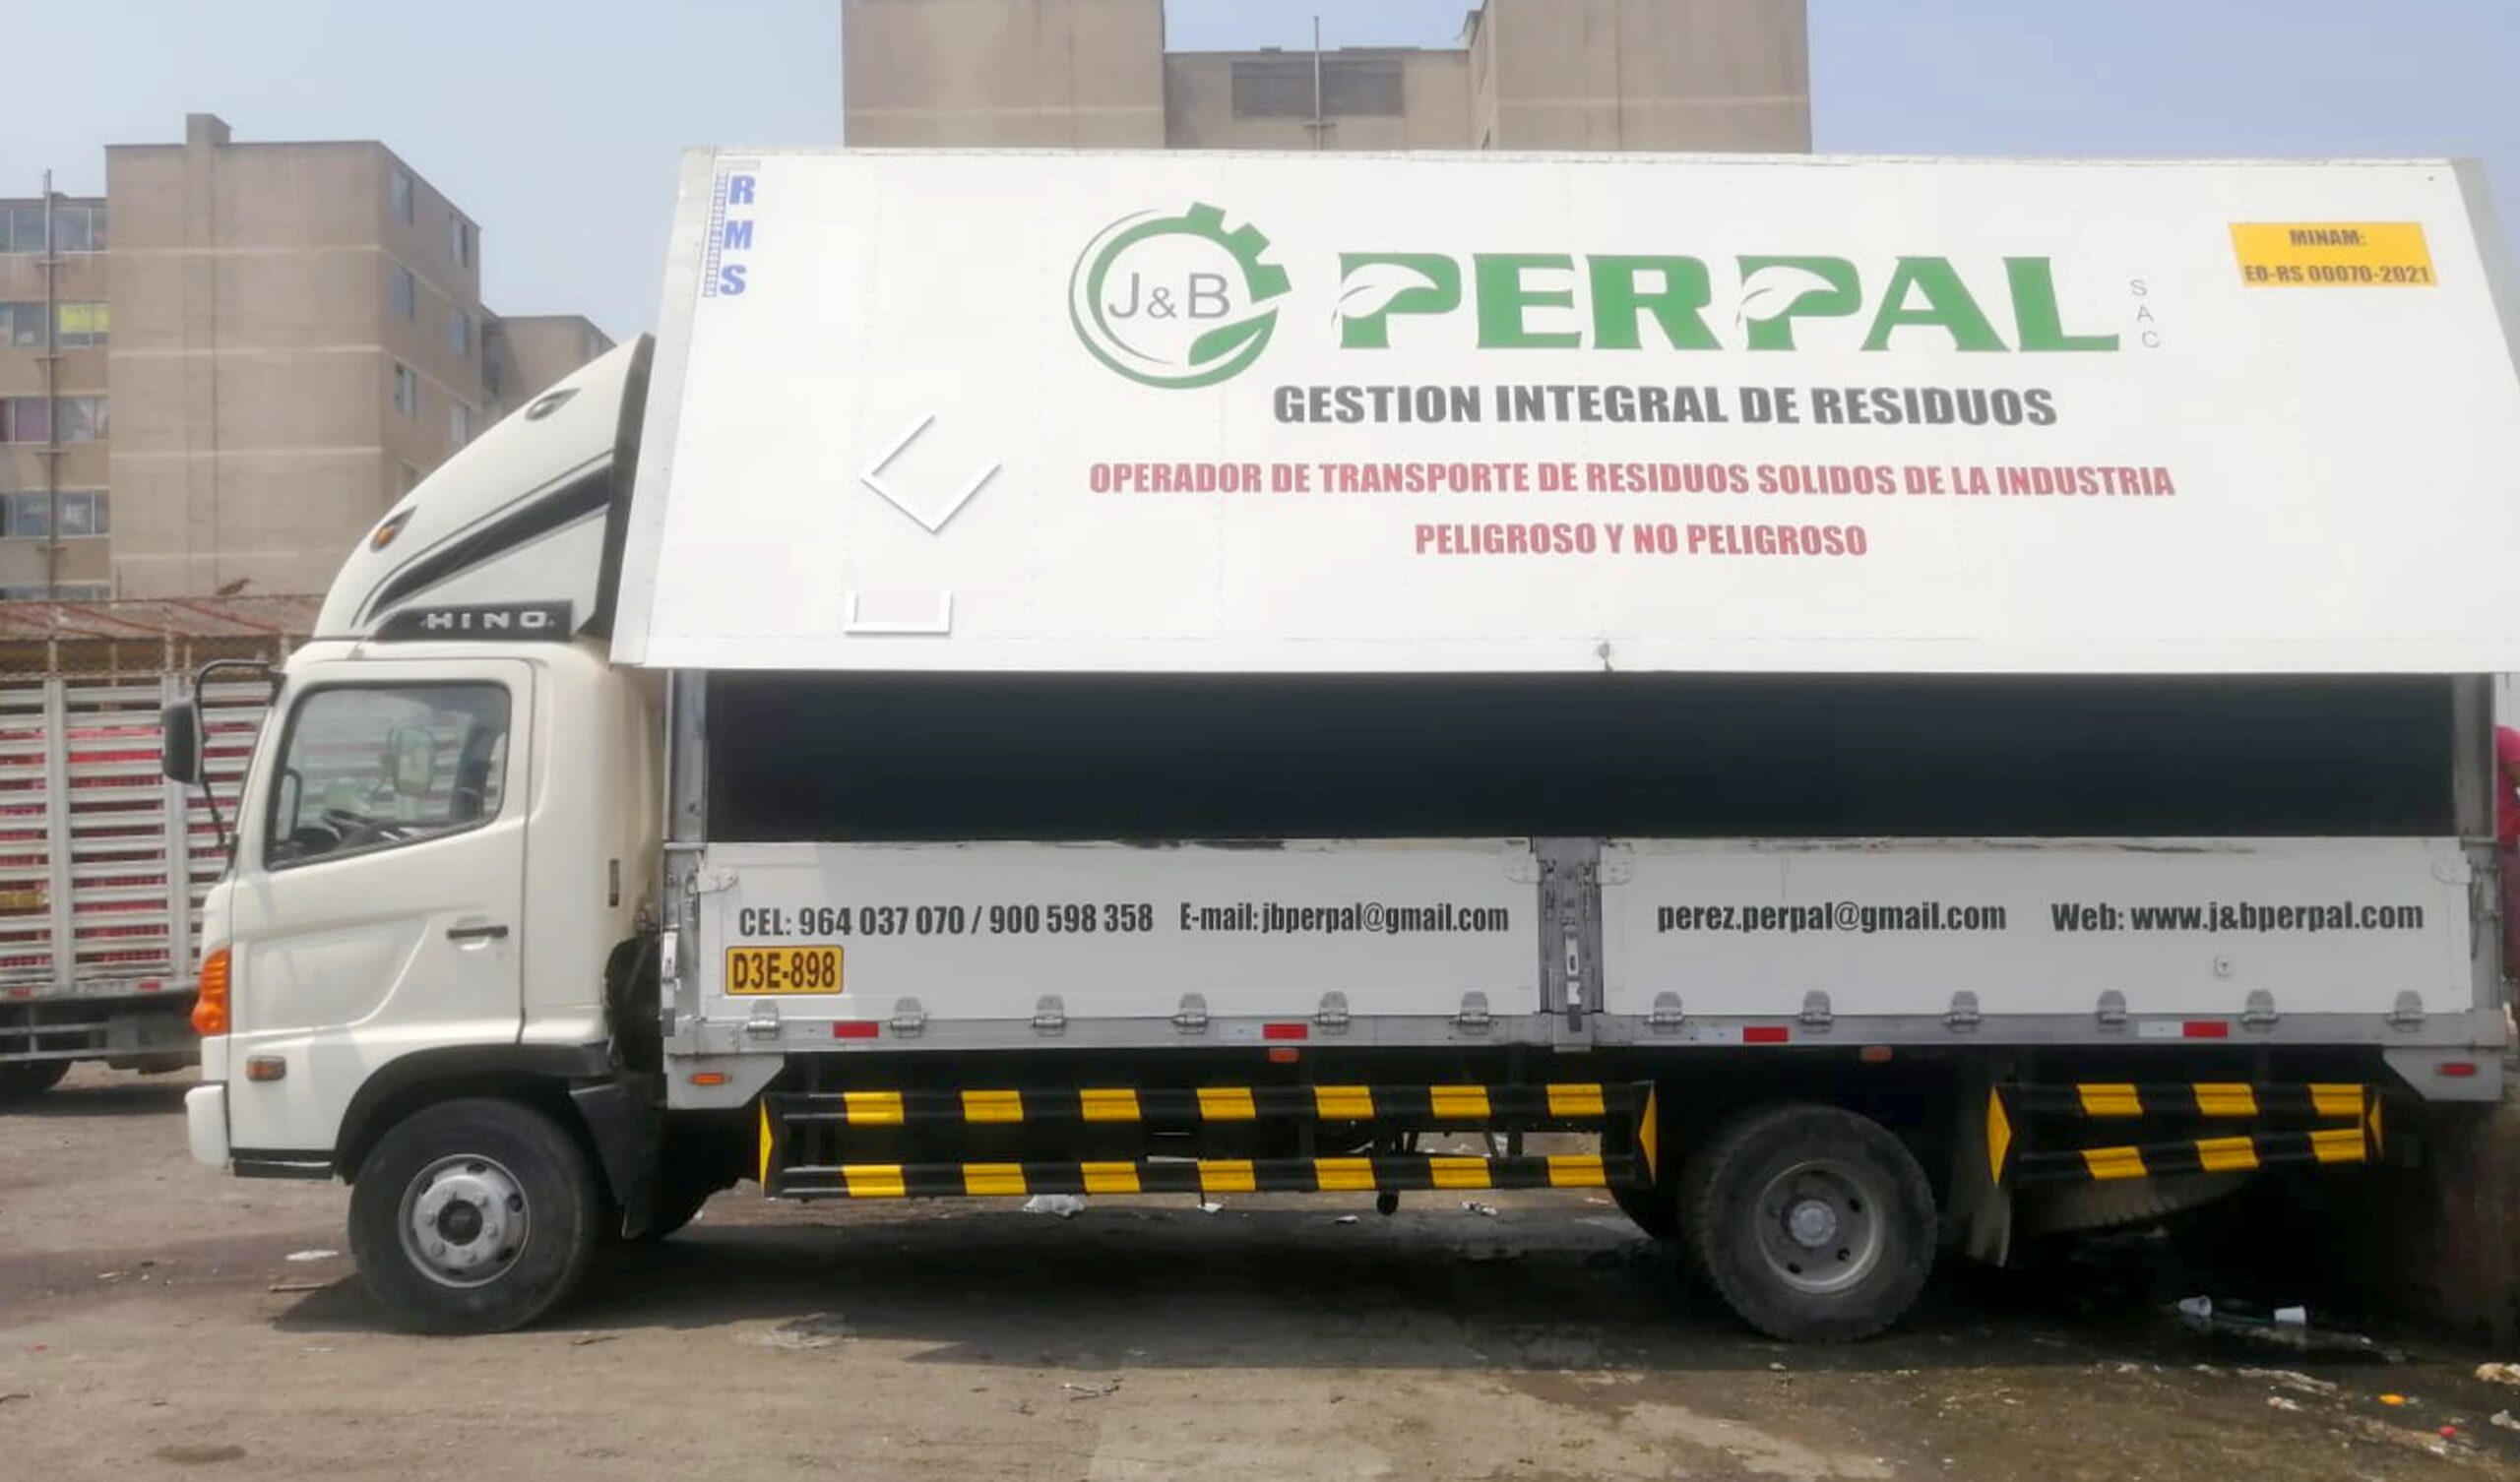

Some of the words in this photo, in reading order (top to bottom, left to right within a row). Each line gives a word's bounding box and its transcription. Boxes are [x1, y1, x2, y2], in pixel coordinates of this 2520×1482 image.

[2288, 228, 2368, 248] MINAM:
[2308, 264, 2432, 284] 00070-2021
[1107, 272, 1232, 322] J&B
[1333, 252, 2121, 354] PERPAL
[1275, 385, 1481, 423] GESTION
[1495, 385, 1729, 423] INTEGRAL
[1739, 386, 1800, 424] DE
[1811, 387, 2057, 427] RESIDUOS
[1090, 463, 1263, 494] OPERADOR
[1272, 463, 1311, 494] DE
[1318, 463, 1530, 494] TRANSPORTE
[1538, 463, 1579, 493] DE
[1586, 463, 1750, 494] RESIDUOS
[1756, 464, 1897, 495] SOLIDOS
[1904, 465, 1945, 496] DE
[1951, 465, 1991, 496] LA
[1995, 465, 2176, 497] INDUSTRIA
[1416, 523, 1597, 556] PELIGROSO
[1604, 524, 1625, 554] Y
[1633, 524, 1678, 555] NO
[1686, 524, 1868, 557] PELIGROSO
[426, 610, 547, 631] HINO
[738, 906, 791, 937] CEL:
[798, 906, 852, 937] 964
[859, 905, 910, 937] 037
[915, 904, 965, 936] 070
[970, 904, 982, 935] /
[989, 903, 1040, 935] 900
[1046, 903, 1097, 934] 598
[1103, 902, 1154, 934] 358
[1657, 900, 2007, 934] perez.perpal@gmail.com
[2050, 901, 2126, 933] Web:
[2131, 900, 2424, 934] www.j&bperpal.com
[730, 950, 837, 991] D3E-898
